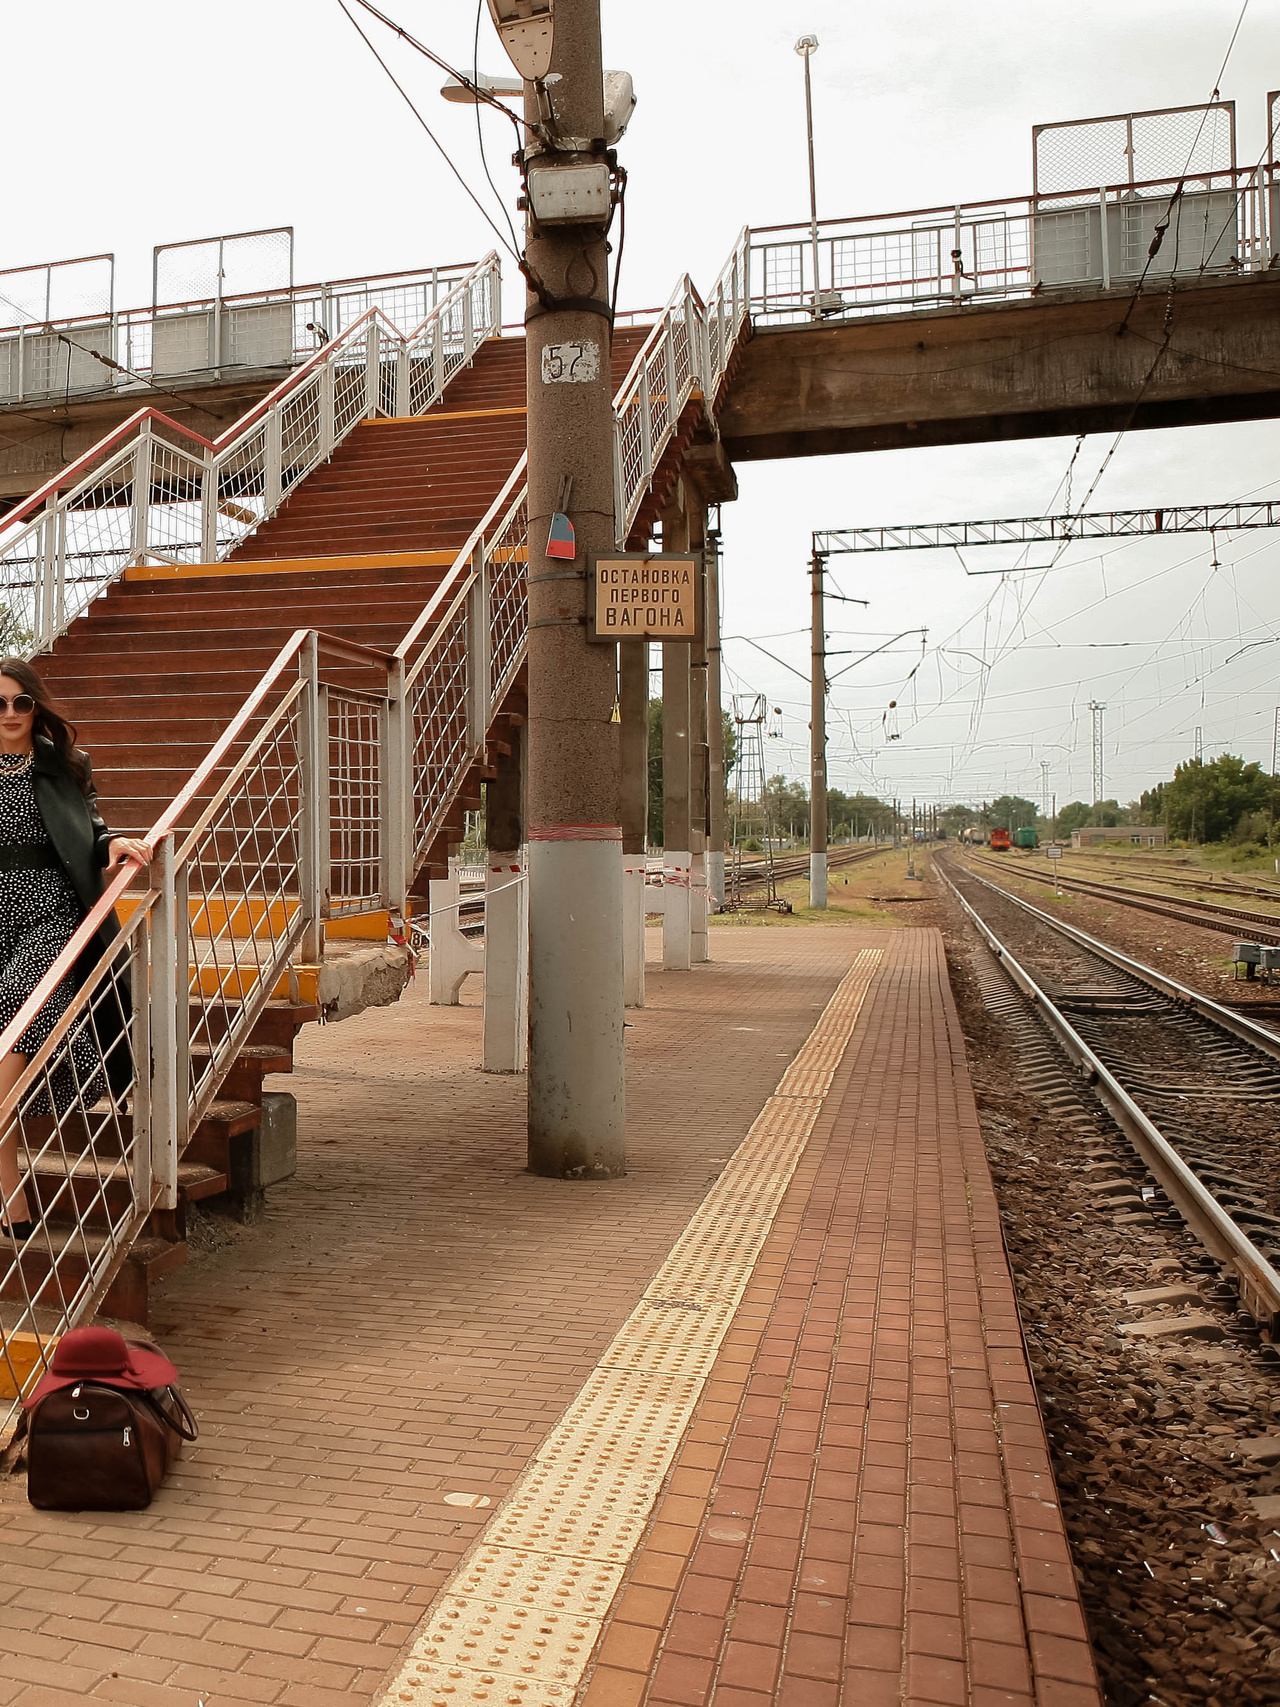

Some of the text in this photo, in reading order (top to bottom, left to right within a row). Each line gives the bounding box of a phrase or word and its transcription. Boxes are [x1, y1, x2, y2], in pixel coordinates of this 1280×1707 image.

[549, 346, 583, 380] 57
[600, 569, 690, 584] ОСТАНОВКА
[610, 588, 680, 603] ПЕРВОГО
[606, 607, 684, 627] ВАГОНА
